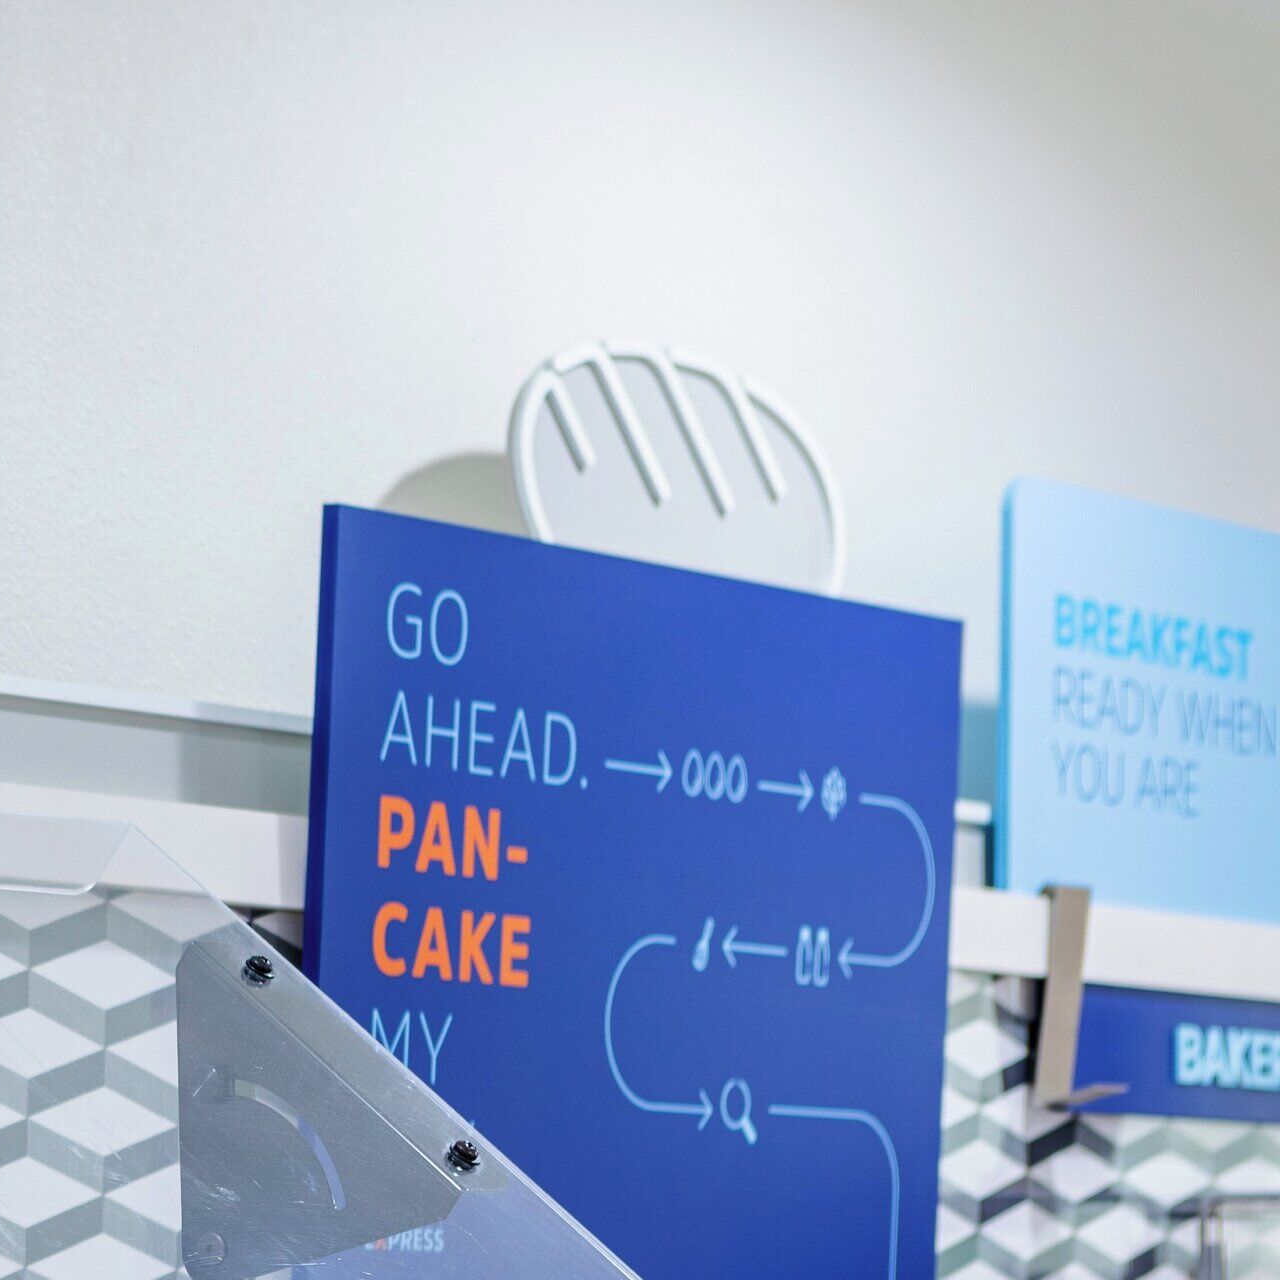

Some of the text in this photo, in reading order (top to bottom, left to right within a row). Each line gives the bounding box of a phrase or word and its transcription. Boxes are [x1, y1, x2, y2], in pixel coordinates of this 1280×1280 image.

[386, 581, 469, 667] GO
[1053, 592, 1253, 680] BREAKFAST
[379, 690, 589, 790] AHEAD.
[1052, 664, 1278, 757] READY WHEN
[1052, 737, 1201, 817] YOU ARE
[376, 793, 529, 882] PAN-
[371, 900, 532, 988] CAKE
[371, 1007, 453, 1086] MY
[1174, 1021, 1280, 1092] BAKE
